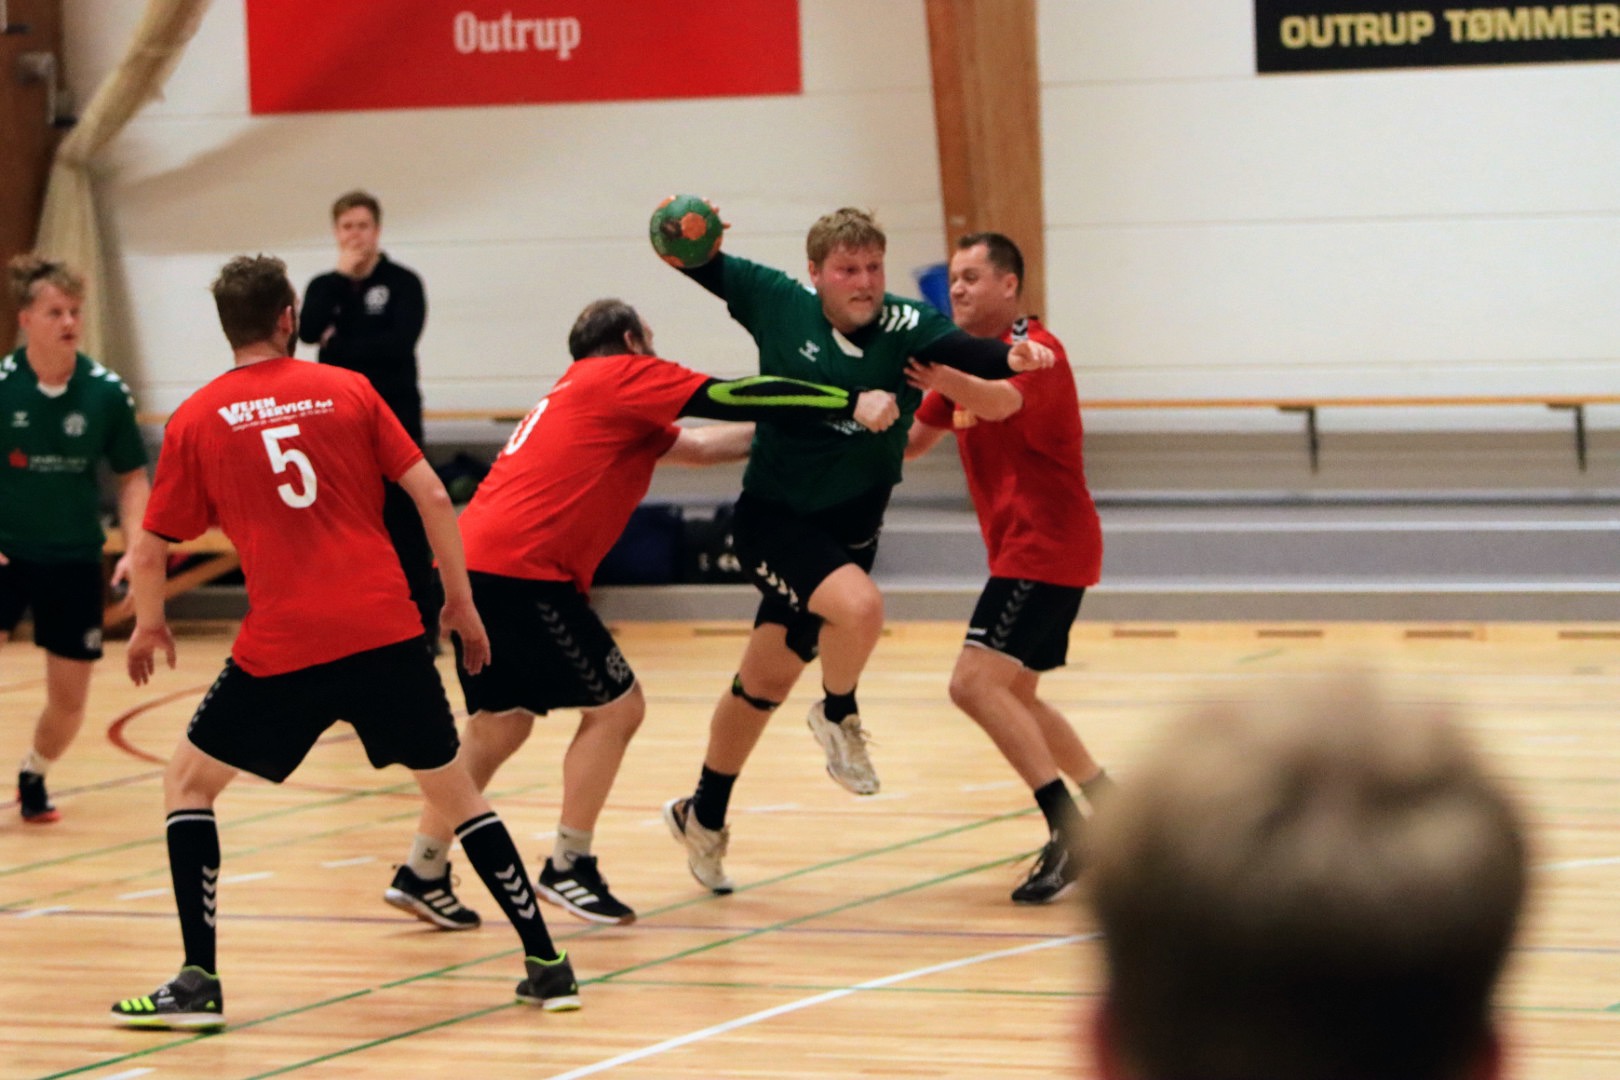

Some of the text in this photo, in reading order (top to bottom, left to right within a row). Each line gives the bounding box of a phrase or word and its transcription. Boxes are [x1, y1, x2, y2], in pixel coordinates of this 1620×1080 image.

[454, 10, 581, 60] Outrup
[1280, 11, 1435, 49] OUTRUP
[257, 399, 313, 420] SERVICE
[261, 424, 318, 509] 5
